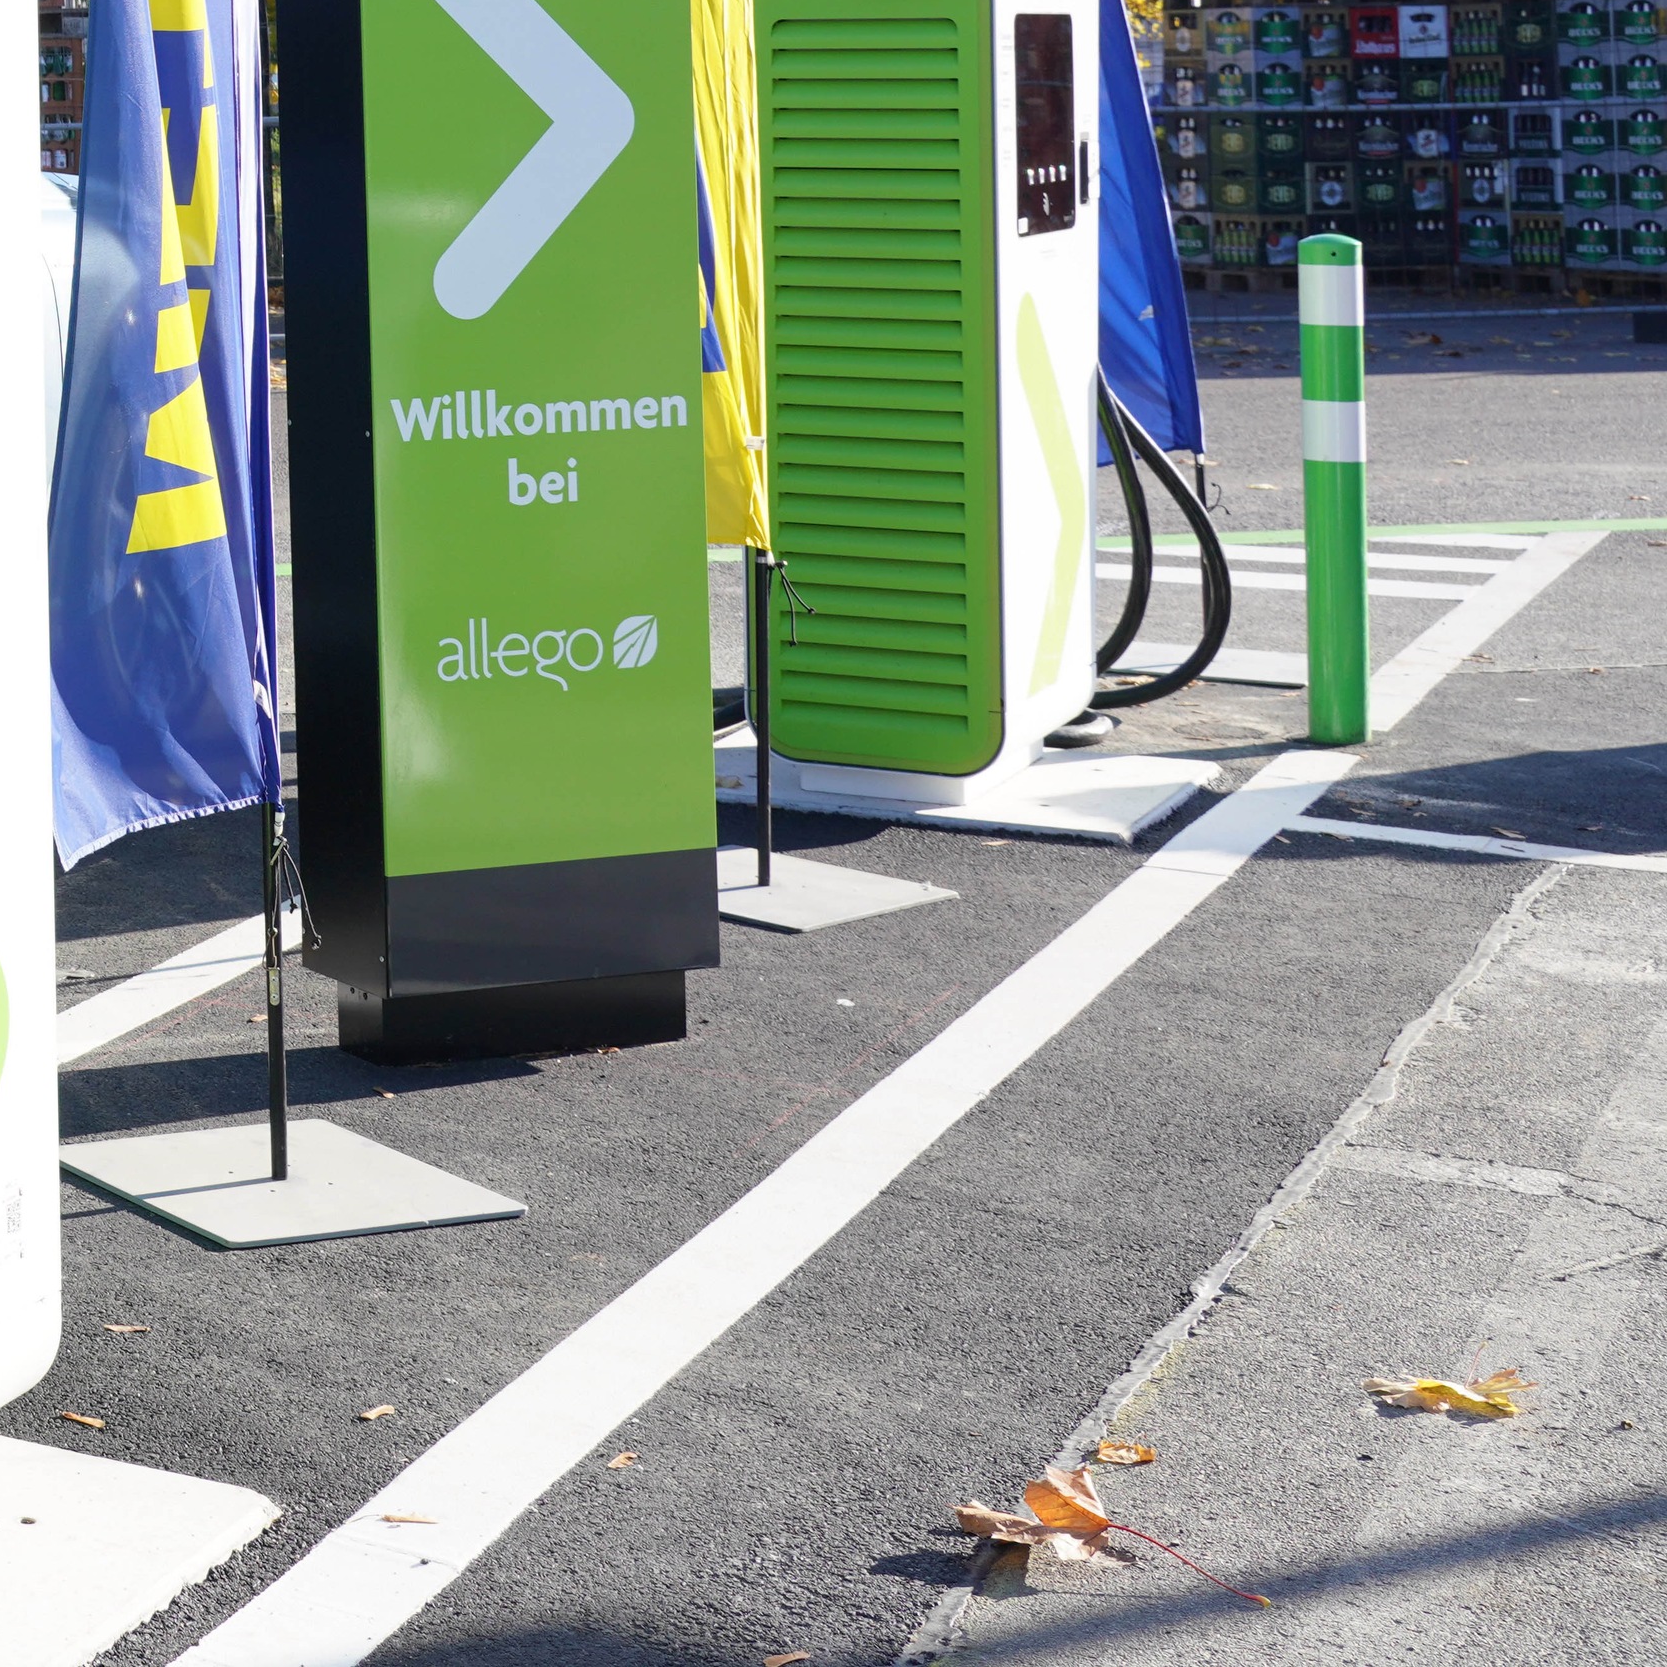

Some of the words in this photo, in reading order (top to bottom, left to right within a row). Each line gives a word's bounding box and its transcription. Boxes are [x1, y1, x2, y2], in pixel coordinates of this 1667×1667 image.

[389, 389, 688, 443] Willkommen
[507, 457, 578, 506] bei
[436, 617, 605, 692] allego
